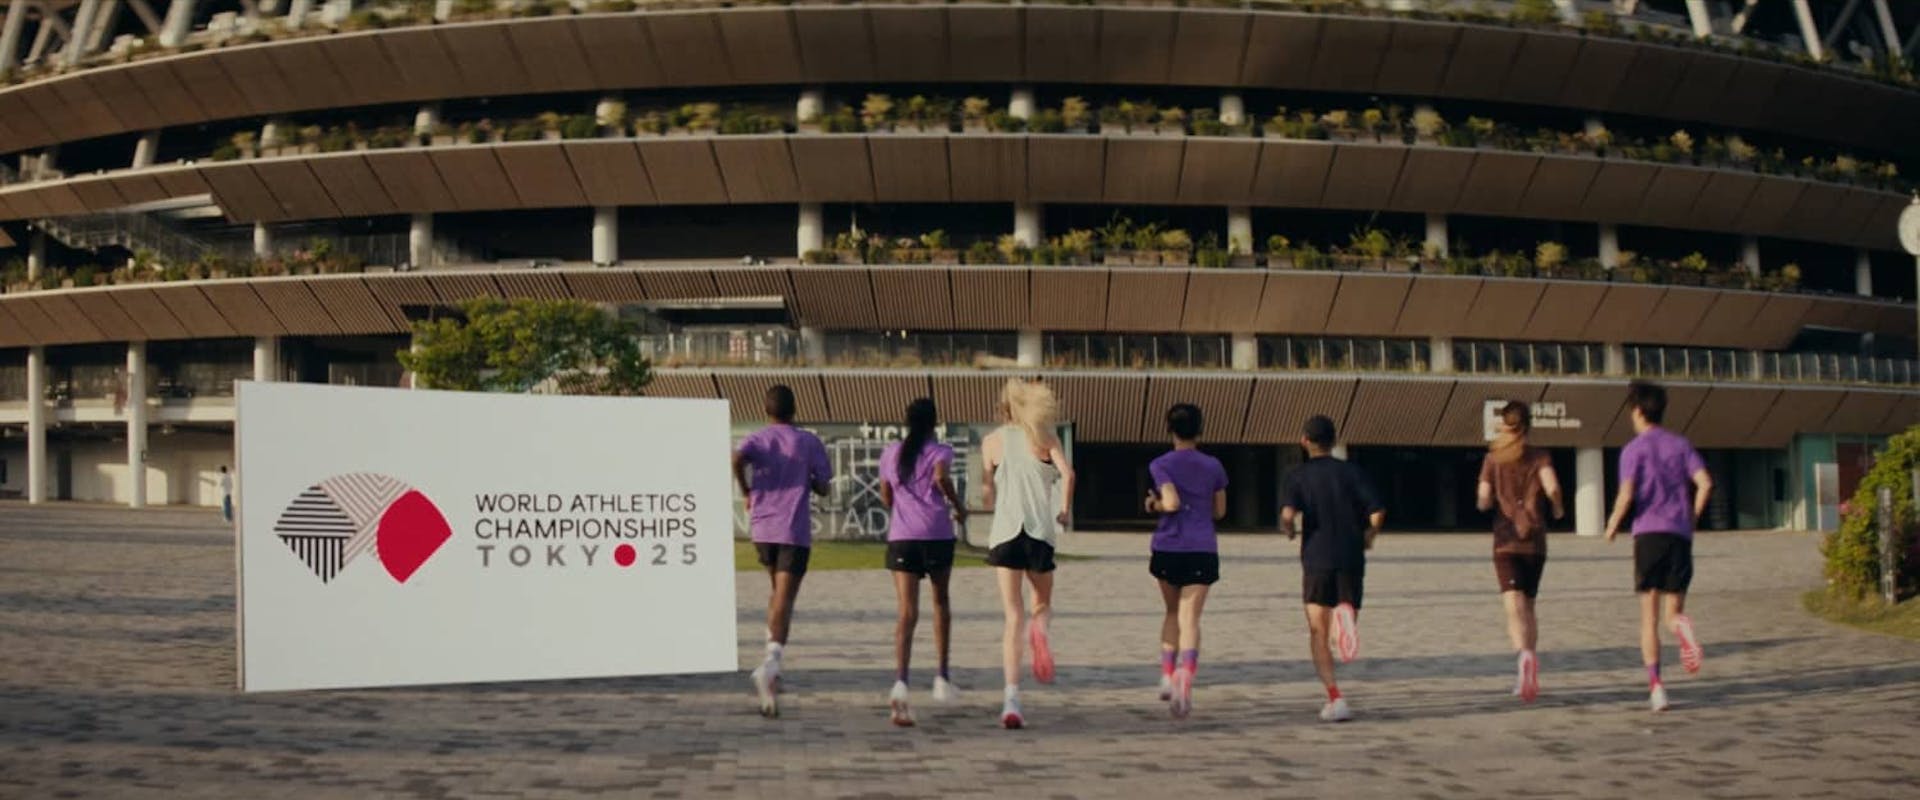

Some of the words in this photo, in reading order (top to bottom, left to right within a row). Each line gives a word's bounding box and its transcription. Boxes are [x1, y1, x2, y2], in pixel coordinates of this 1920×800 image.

[475, 493, 562, 512] WORLD
[570, 493, 697, 512] ATHLETICS
[474, 518, 697, 539] CHAMPIONSHIPS
[651, 543, 697, 565] 25
